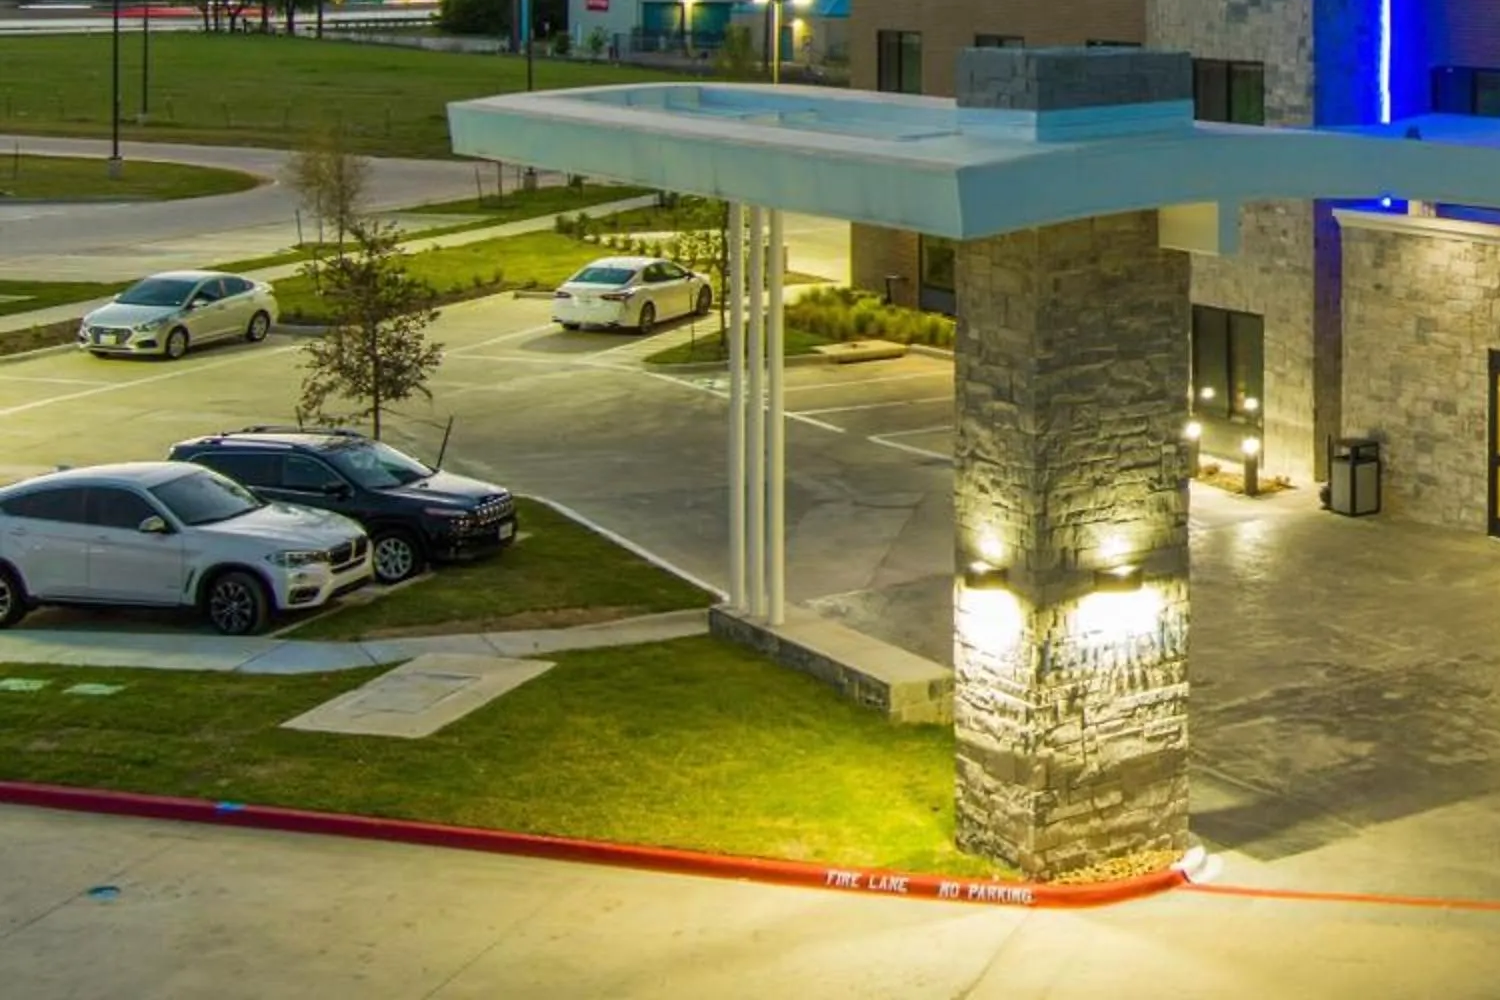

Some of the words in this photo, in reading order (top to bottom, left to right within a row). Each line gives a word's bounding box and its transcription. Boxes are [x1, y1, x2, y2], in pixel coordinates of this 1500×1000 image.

[826, 869, 862, 889] FIRE
[868, 874, 910, 893] LANE
[938, 881, 961, 899] NO
[968, 884, 1034, 905] PARKING
